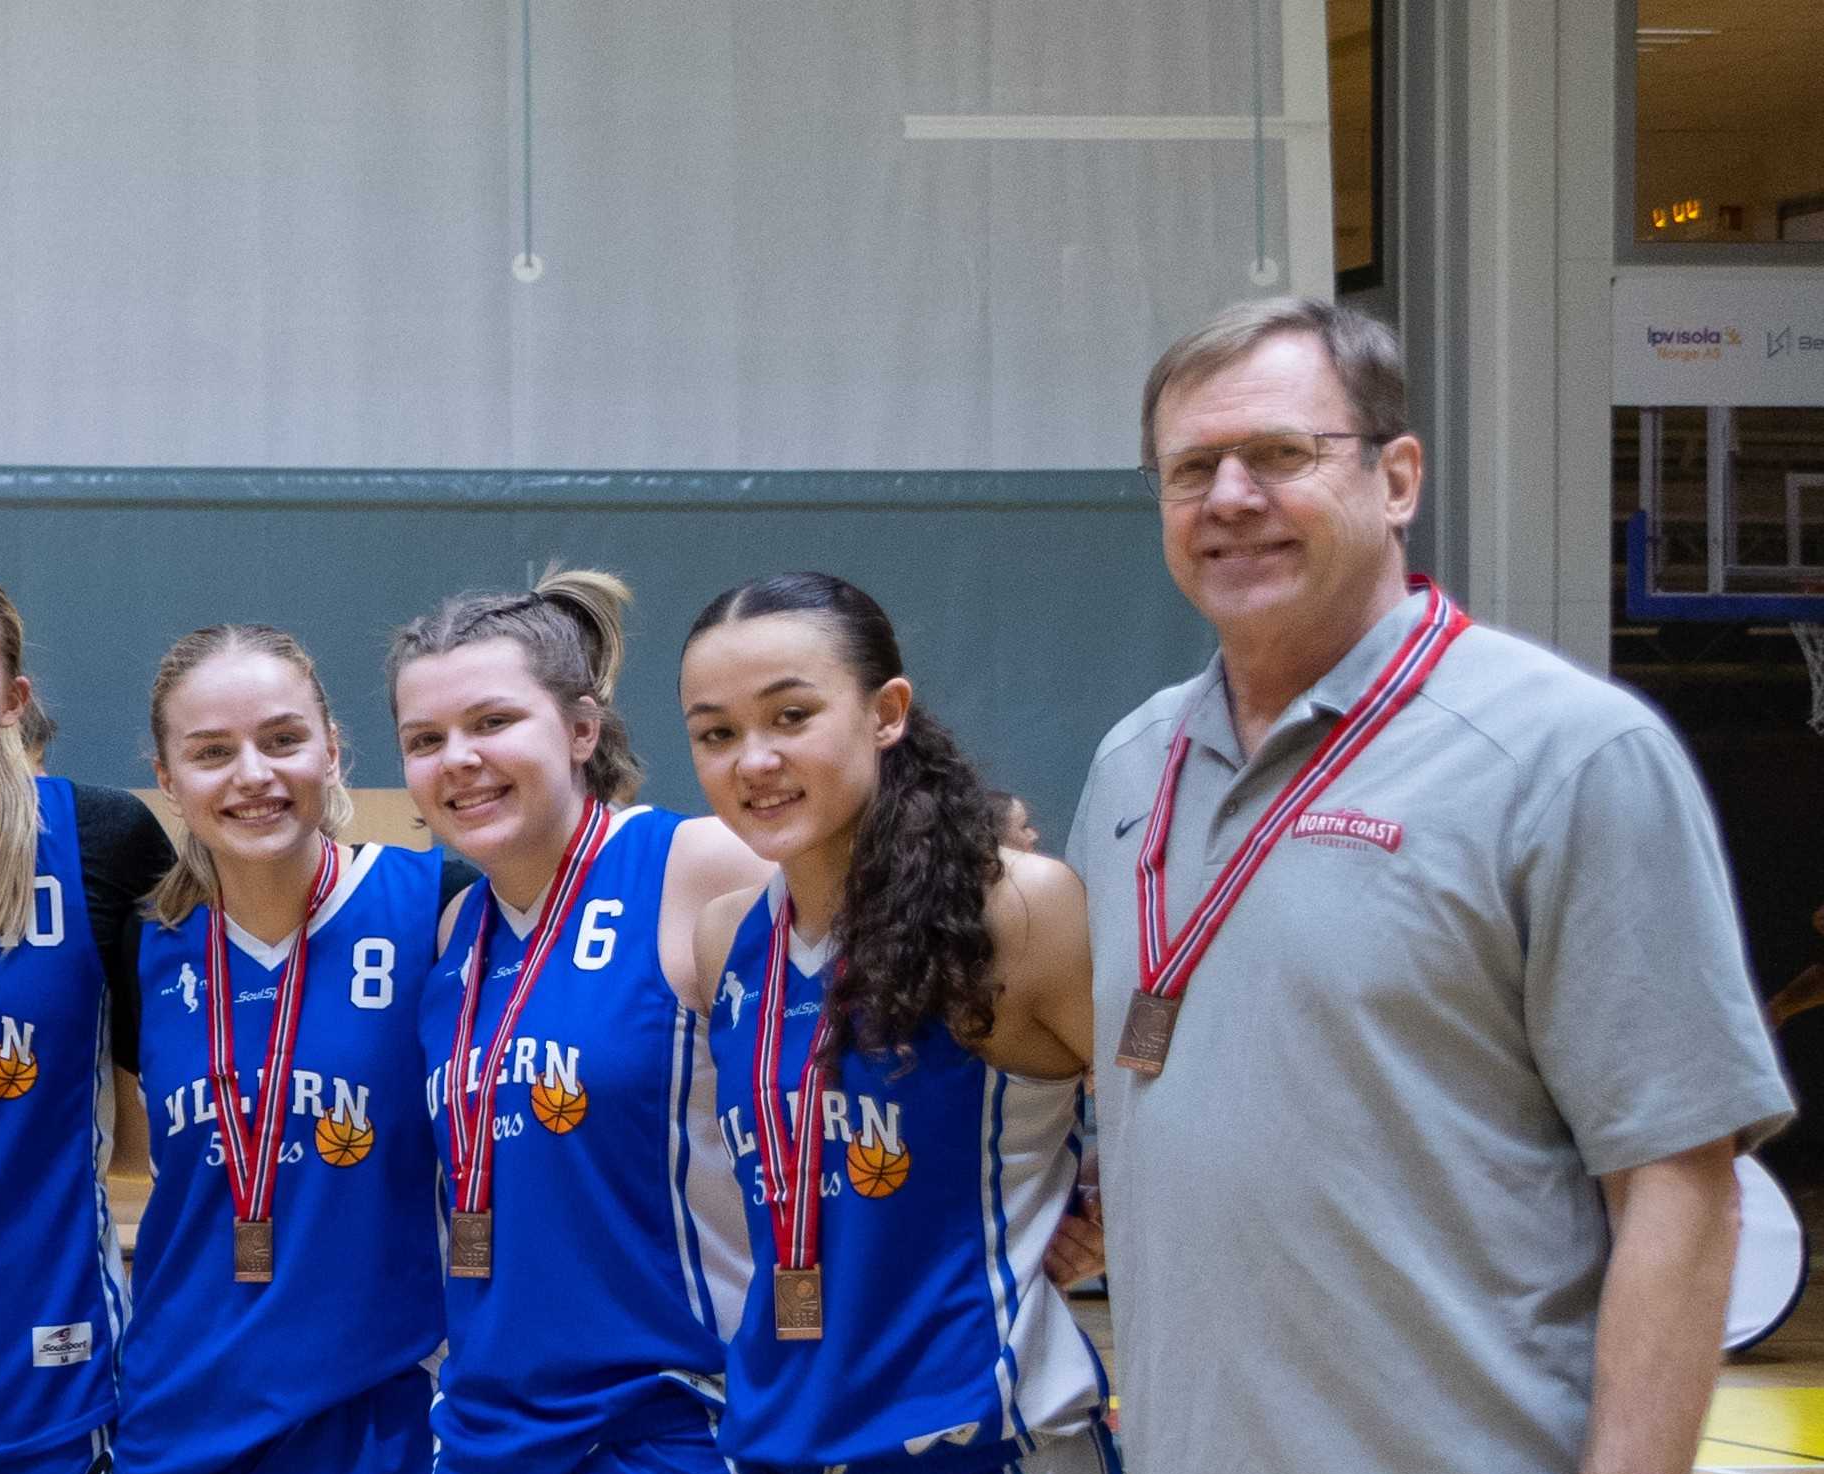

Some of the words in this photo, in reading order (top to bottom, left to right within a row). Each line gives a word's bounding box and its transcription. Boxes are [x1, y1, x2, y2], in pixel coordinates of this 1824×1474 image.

[1295, 815, 1346, 832] NORTH
[1349, 820, 1398, 845] COAST
[572, 898, 624, 971] 6
[350, 937, 396, 1010] 8
